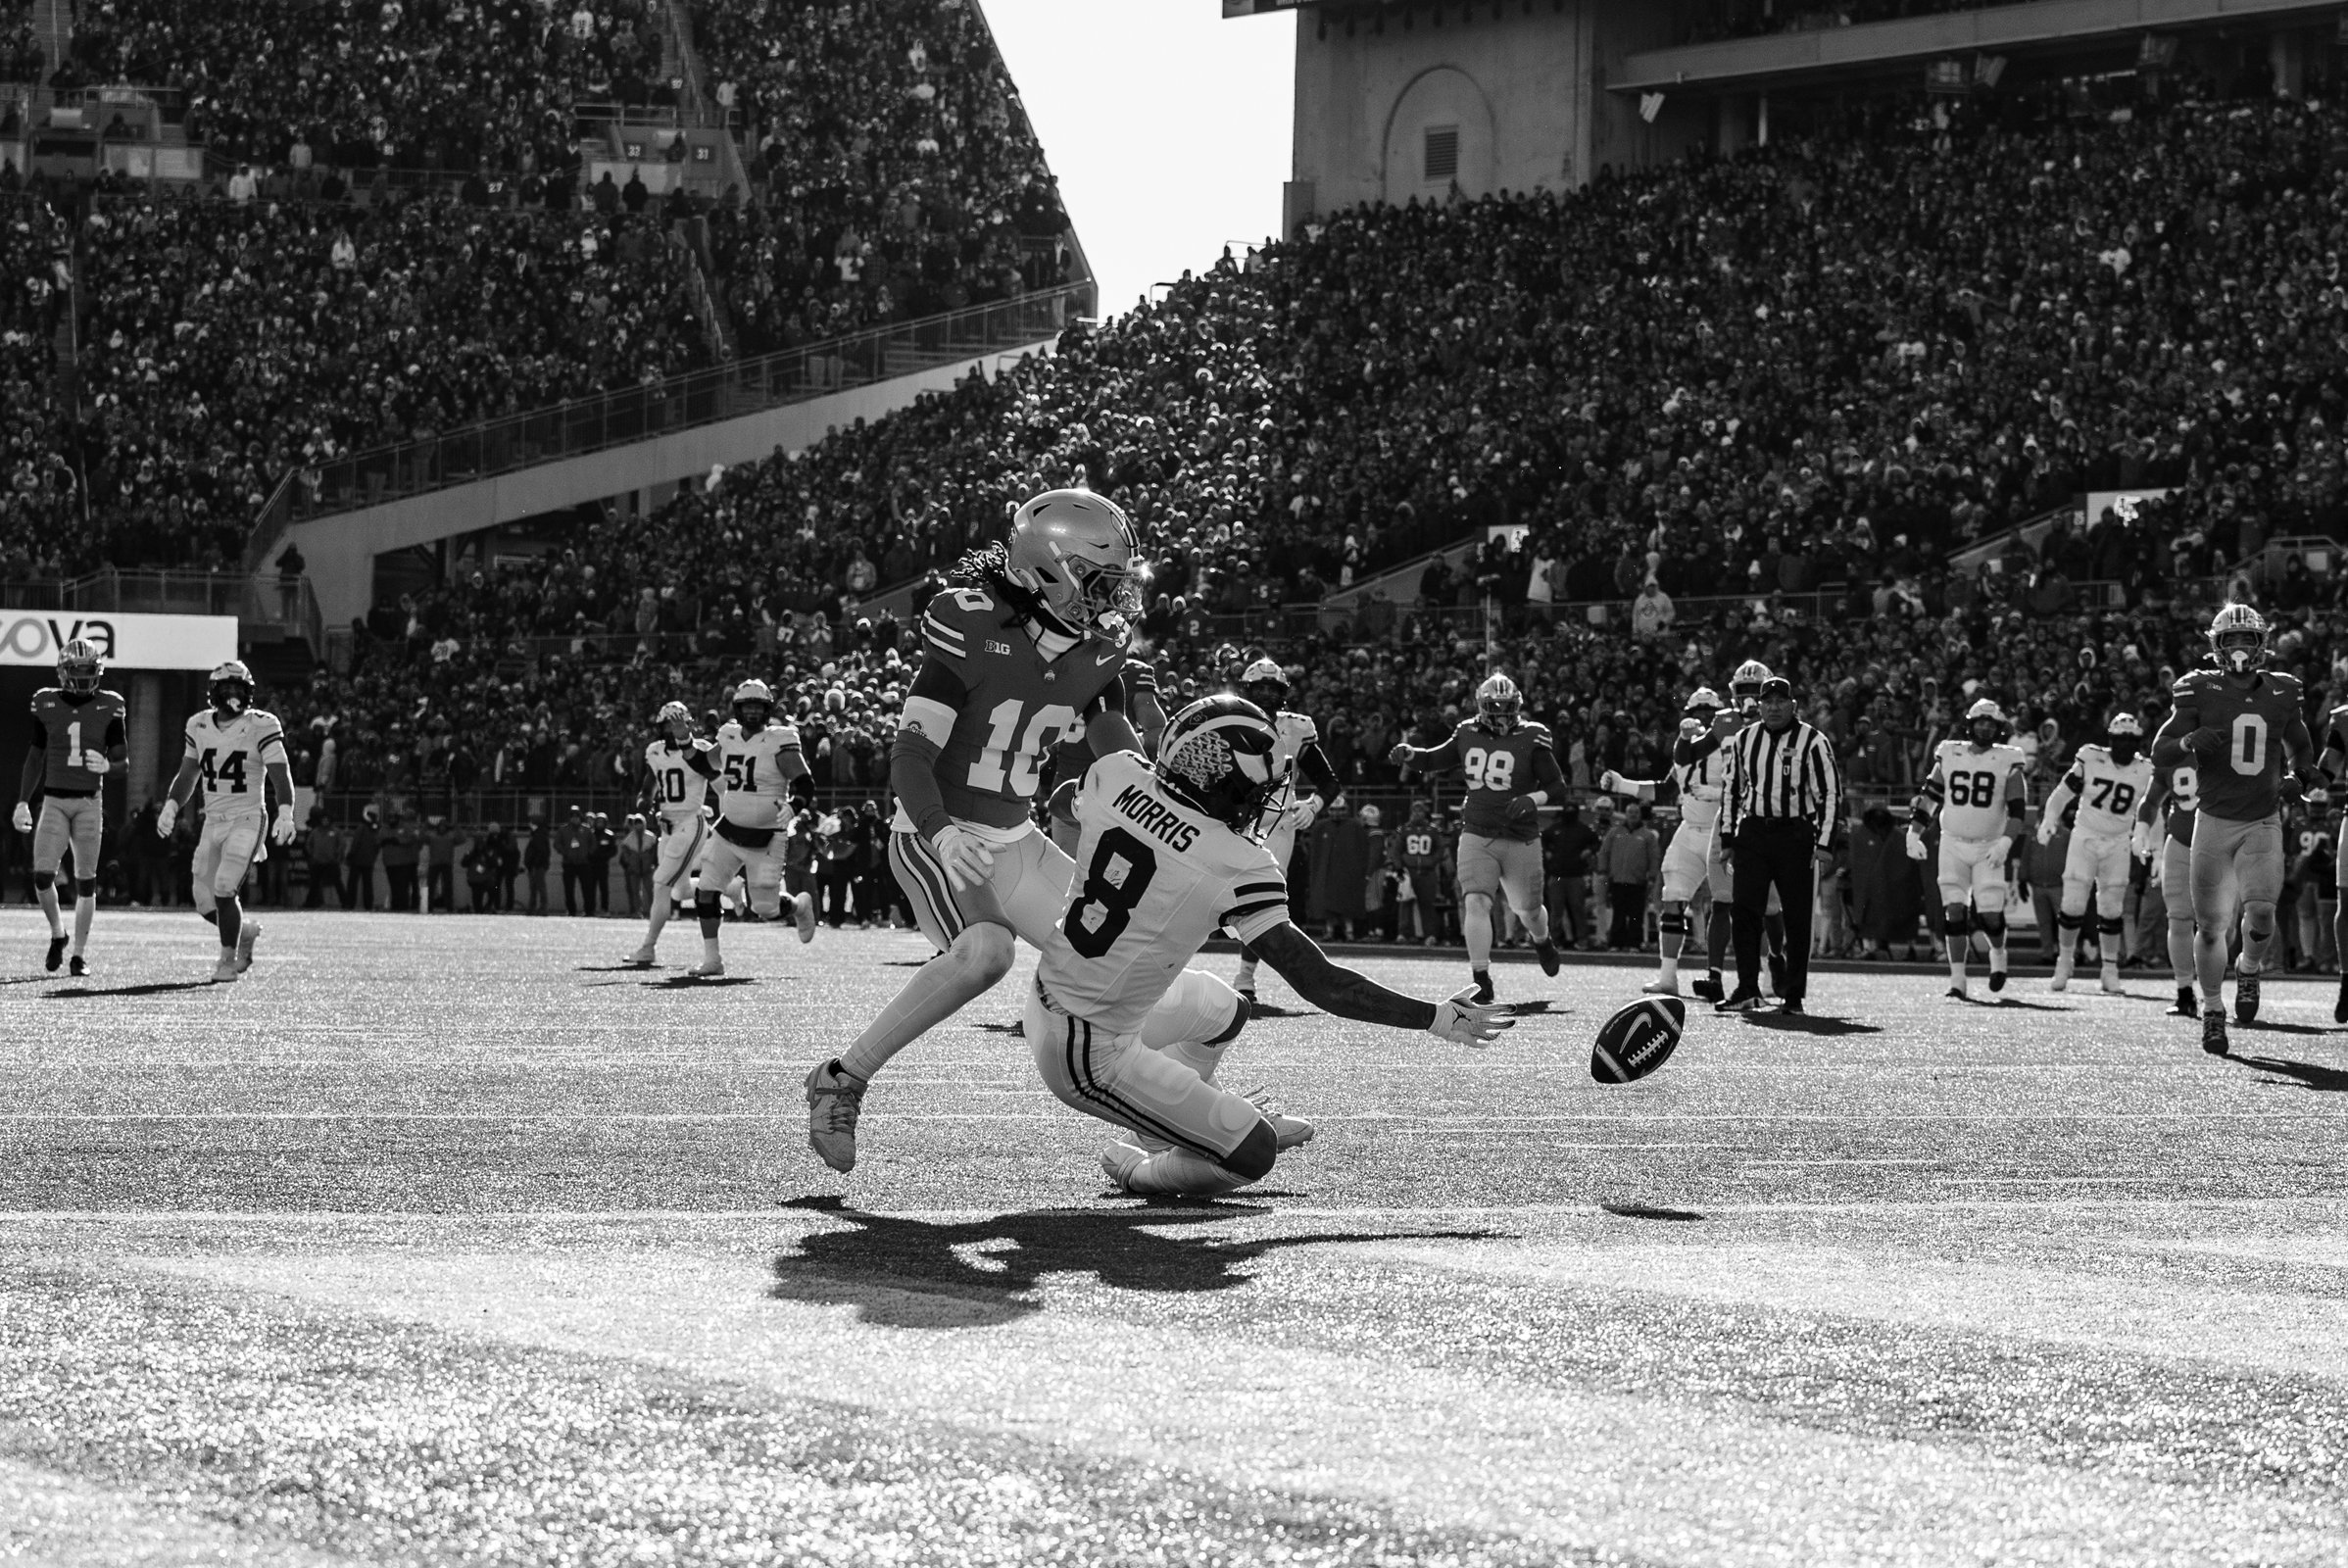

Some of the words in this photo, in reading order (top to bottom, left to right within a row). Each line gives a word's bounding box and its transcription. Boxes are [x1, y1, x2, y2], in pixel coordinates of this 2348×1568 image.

[0, 617, 115, 660] ova
[1189, 618, 1200, 637] 2
[67, 720, 83, 766] 1
[2230, 713, 2268, 776] 0
[199, 748, 248, 794] 44
[723, 754, 758, 792] 51
[1464, 747, 1515, 791] 98
[1949, 770, 1996, 808] 68
[2091, 777, 2135, 815] 78
[1111, 784, 1200, 853] MORRIS
[1406, 834, 1432, 855] 60
[1063, 826, 1157, 958] 8
